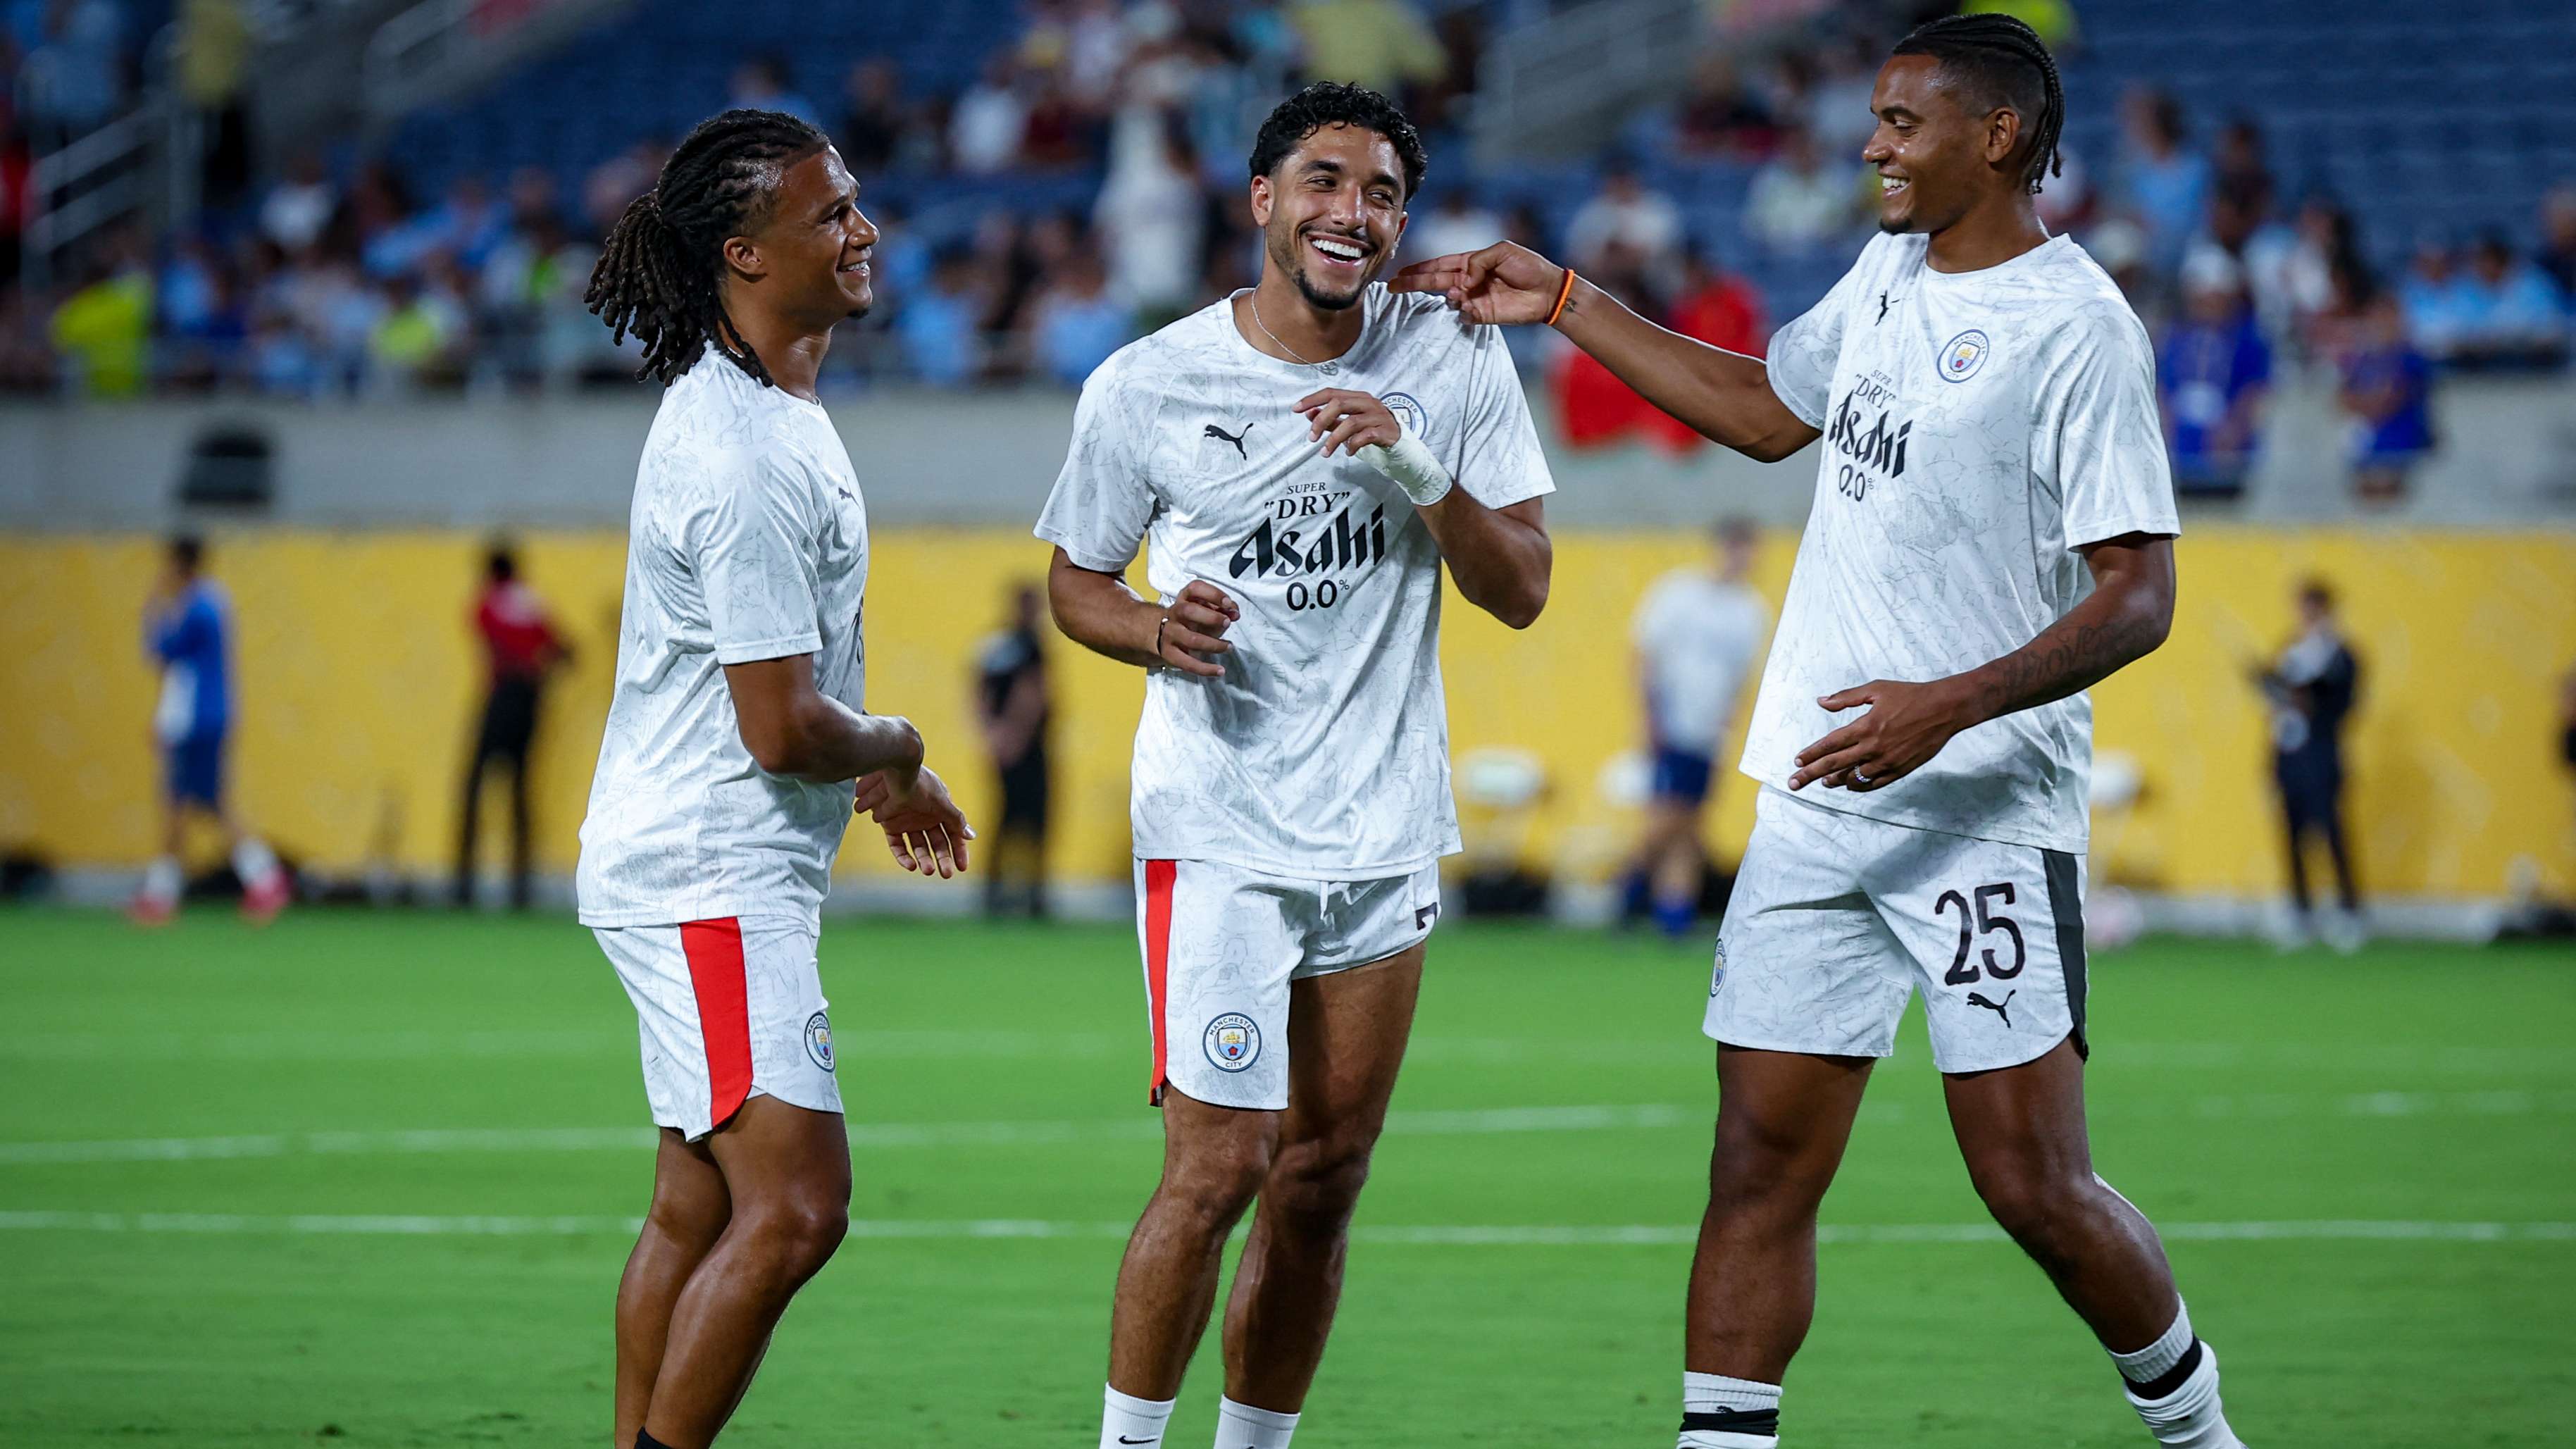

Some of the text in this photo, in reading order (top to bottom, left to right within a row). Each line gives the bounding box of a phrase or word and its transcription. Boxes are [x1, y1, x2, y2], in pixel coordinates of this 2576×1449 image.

[1828, 389, 1913, 478] Asahi
[1286, 482, 1326, 495] SUPER
[1228, 502, 1385, 579] Asahi
[1935, 882, 2025, 986] 25
[1209, 1017, 1255, 1036] MANCHESTER
